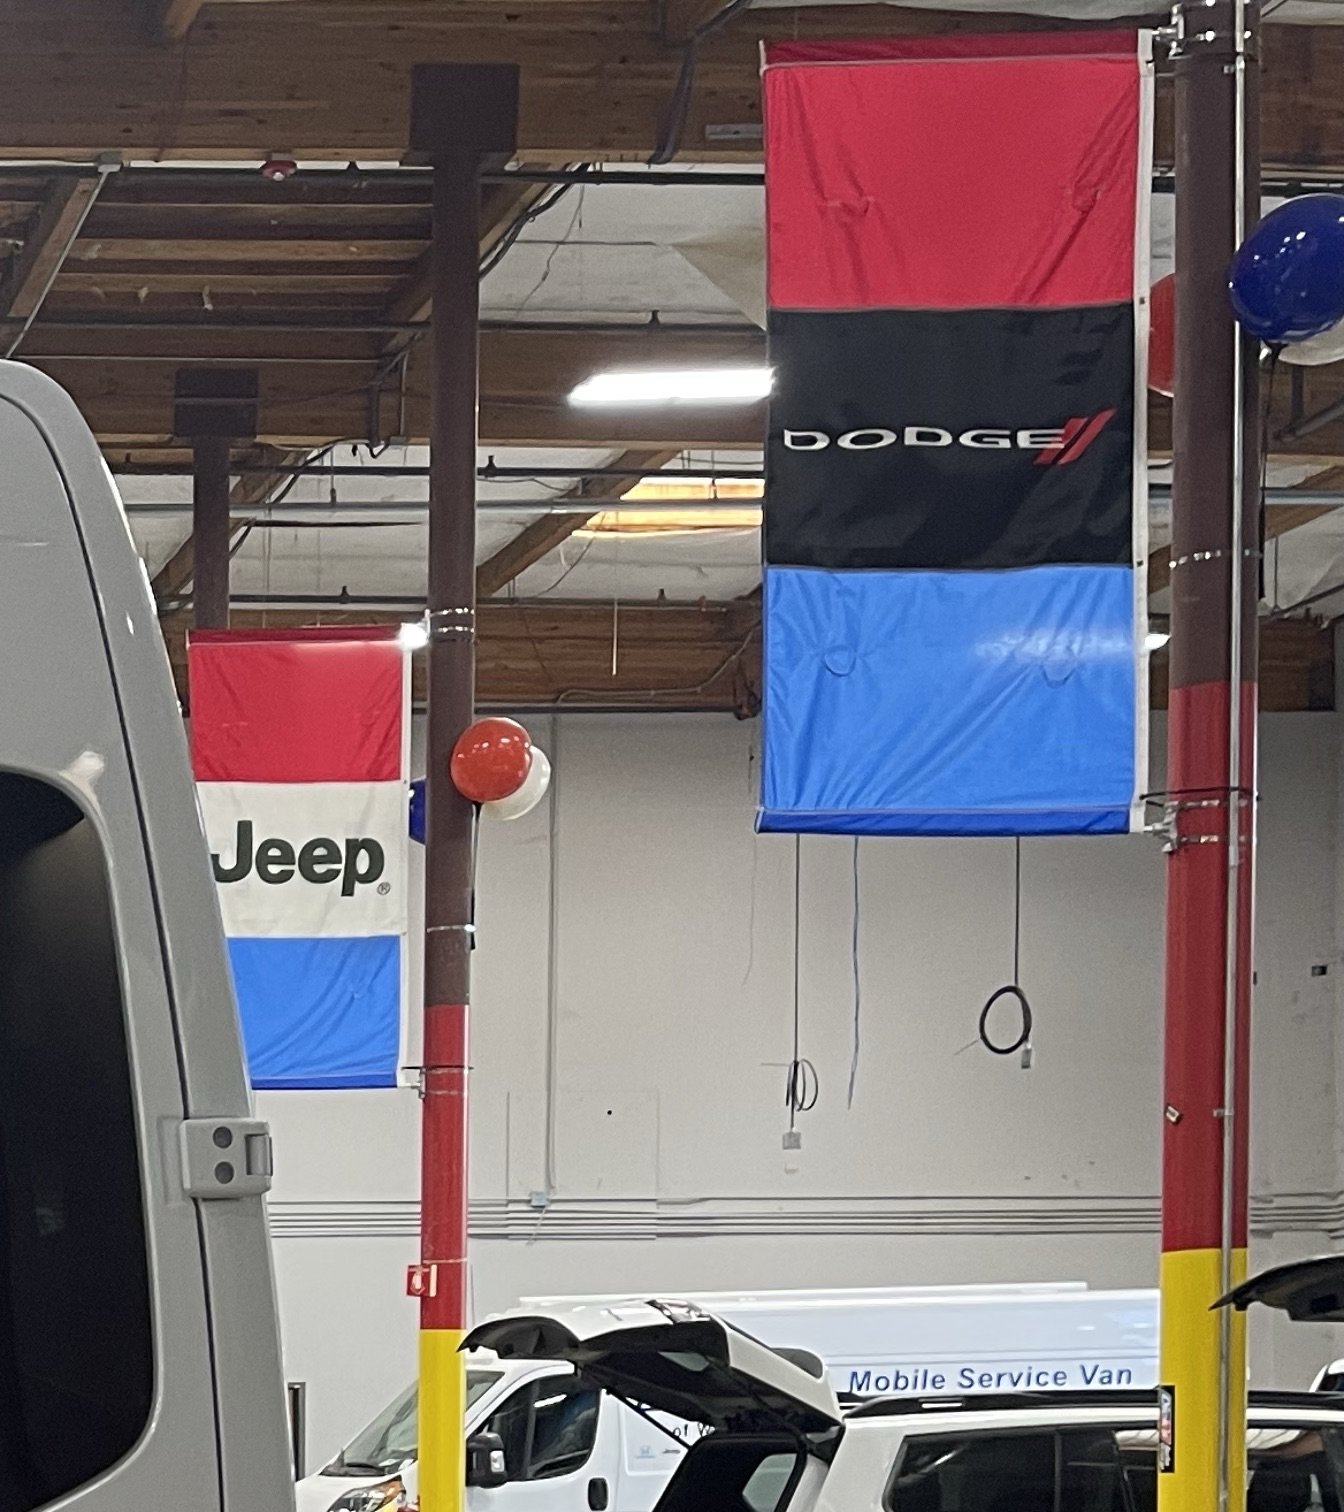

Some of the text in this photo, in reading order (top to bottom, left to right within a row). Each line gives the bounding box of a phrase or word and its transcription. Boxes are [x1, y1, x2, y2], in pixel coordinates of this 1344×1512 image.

[783, 426, 1066, 450] DODGE
[210, 819, 385, 897] Jeep
[849, 1364, 1133, 1393] Mobile Service Van
